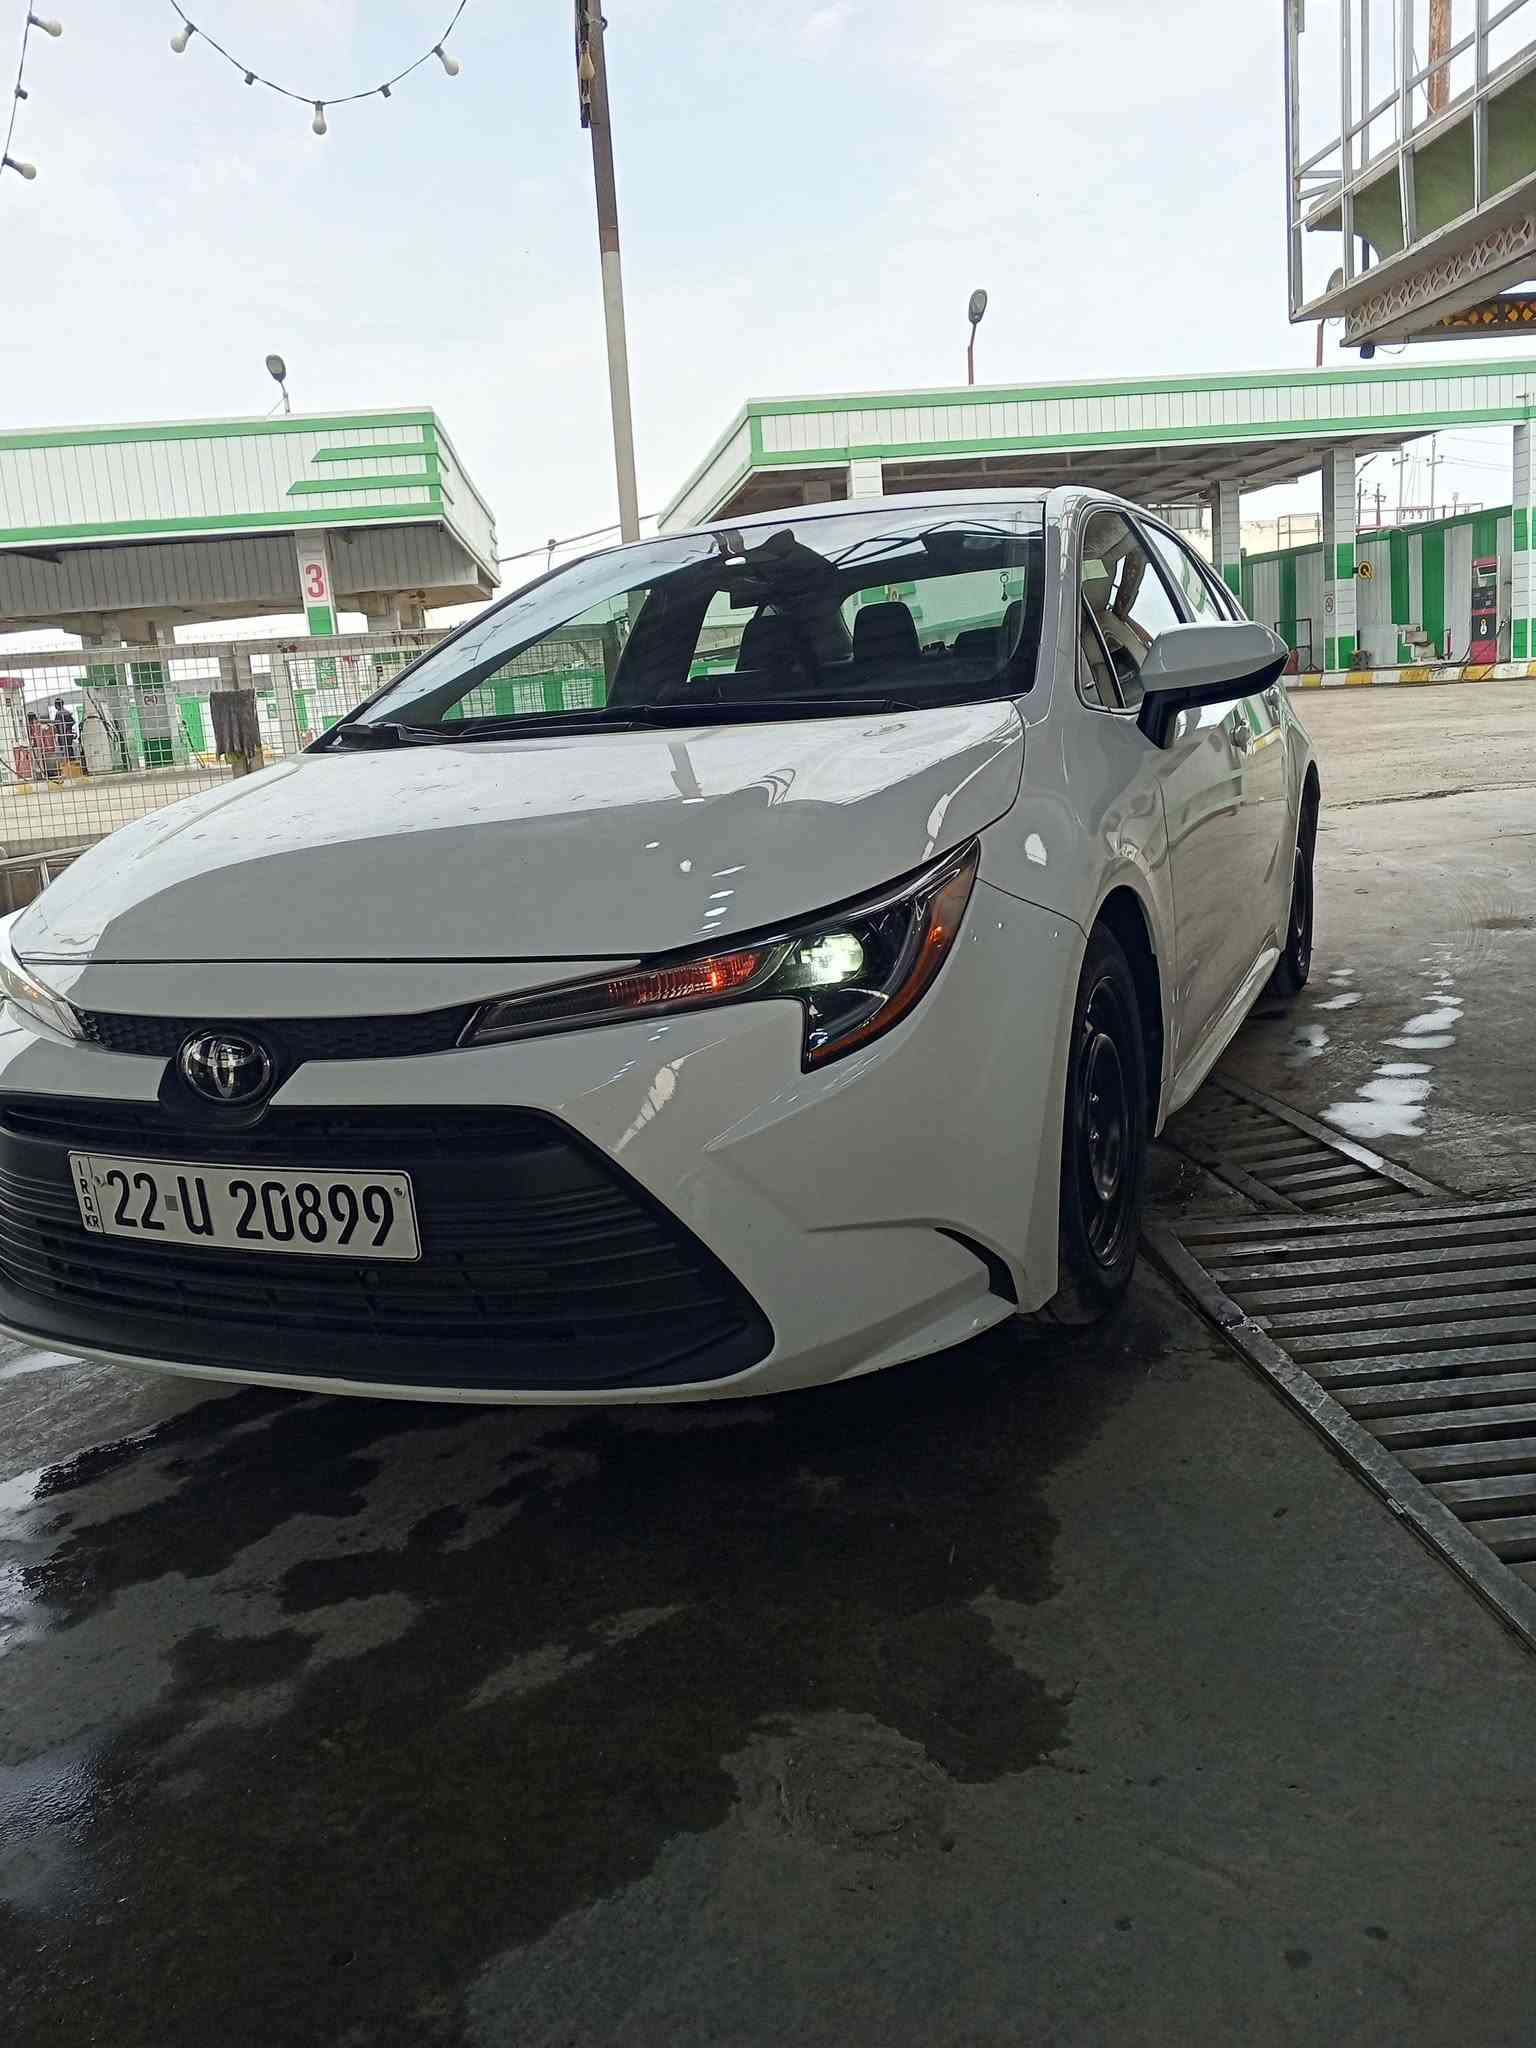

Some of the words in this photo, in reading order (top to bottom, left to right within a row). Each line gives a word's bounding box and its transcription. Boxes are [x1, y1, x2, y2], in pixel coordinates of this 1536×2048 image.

[306, 564, 324, 597] 3
[107, 1170, 165, 1230] 22
[229, 1180, 394, 1247] 20899
